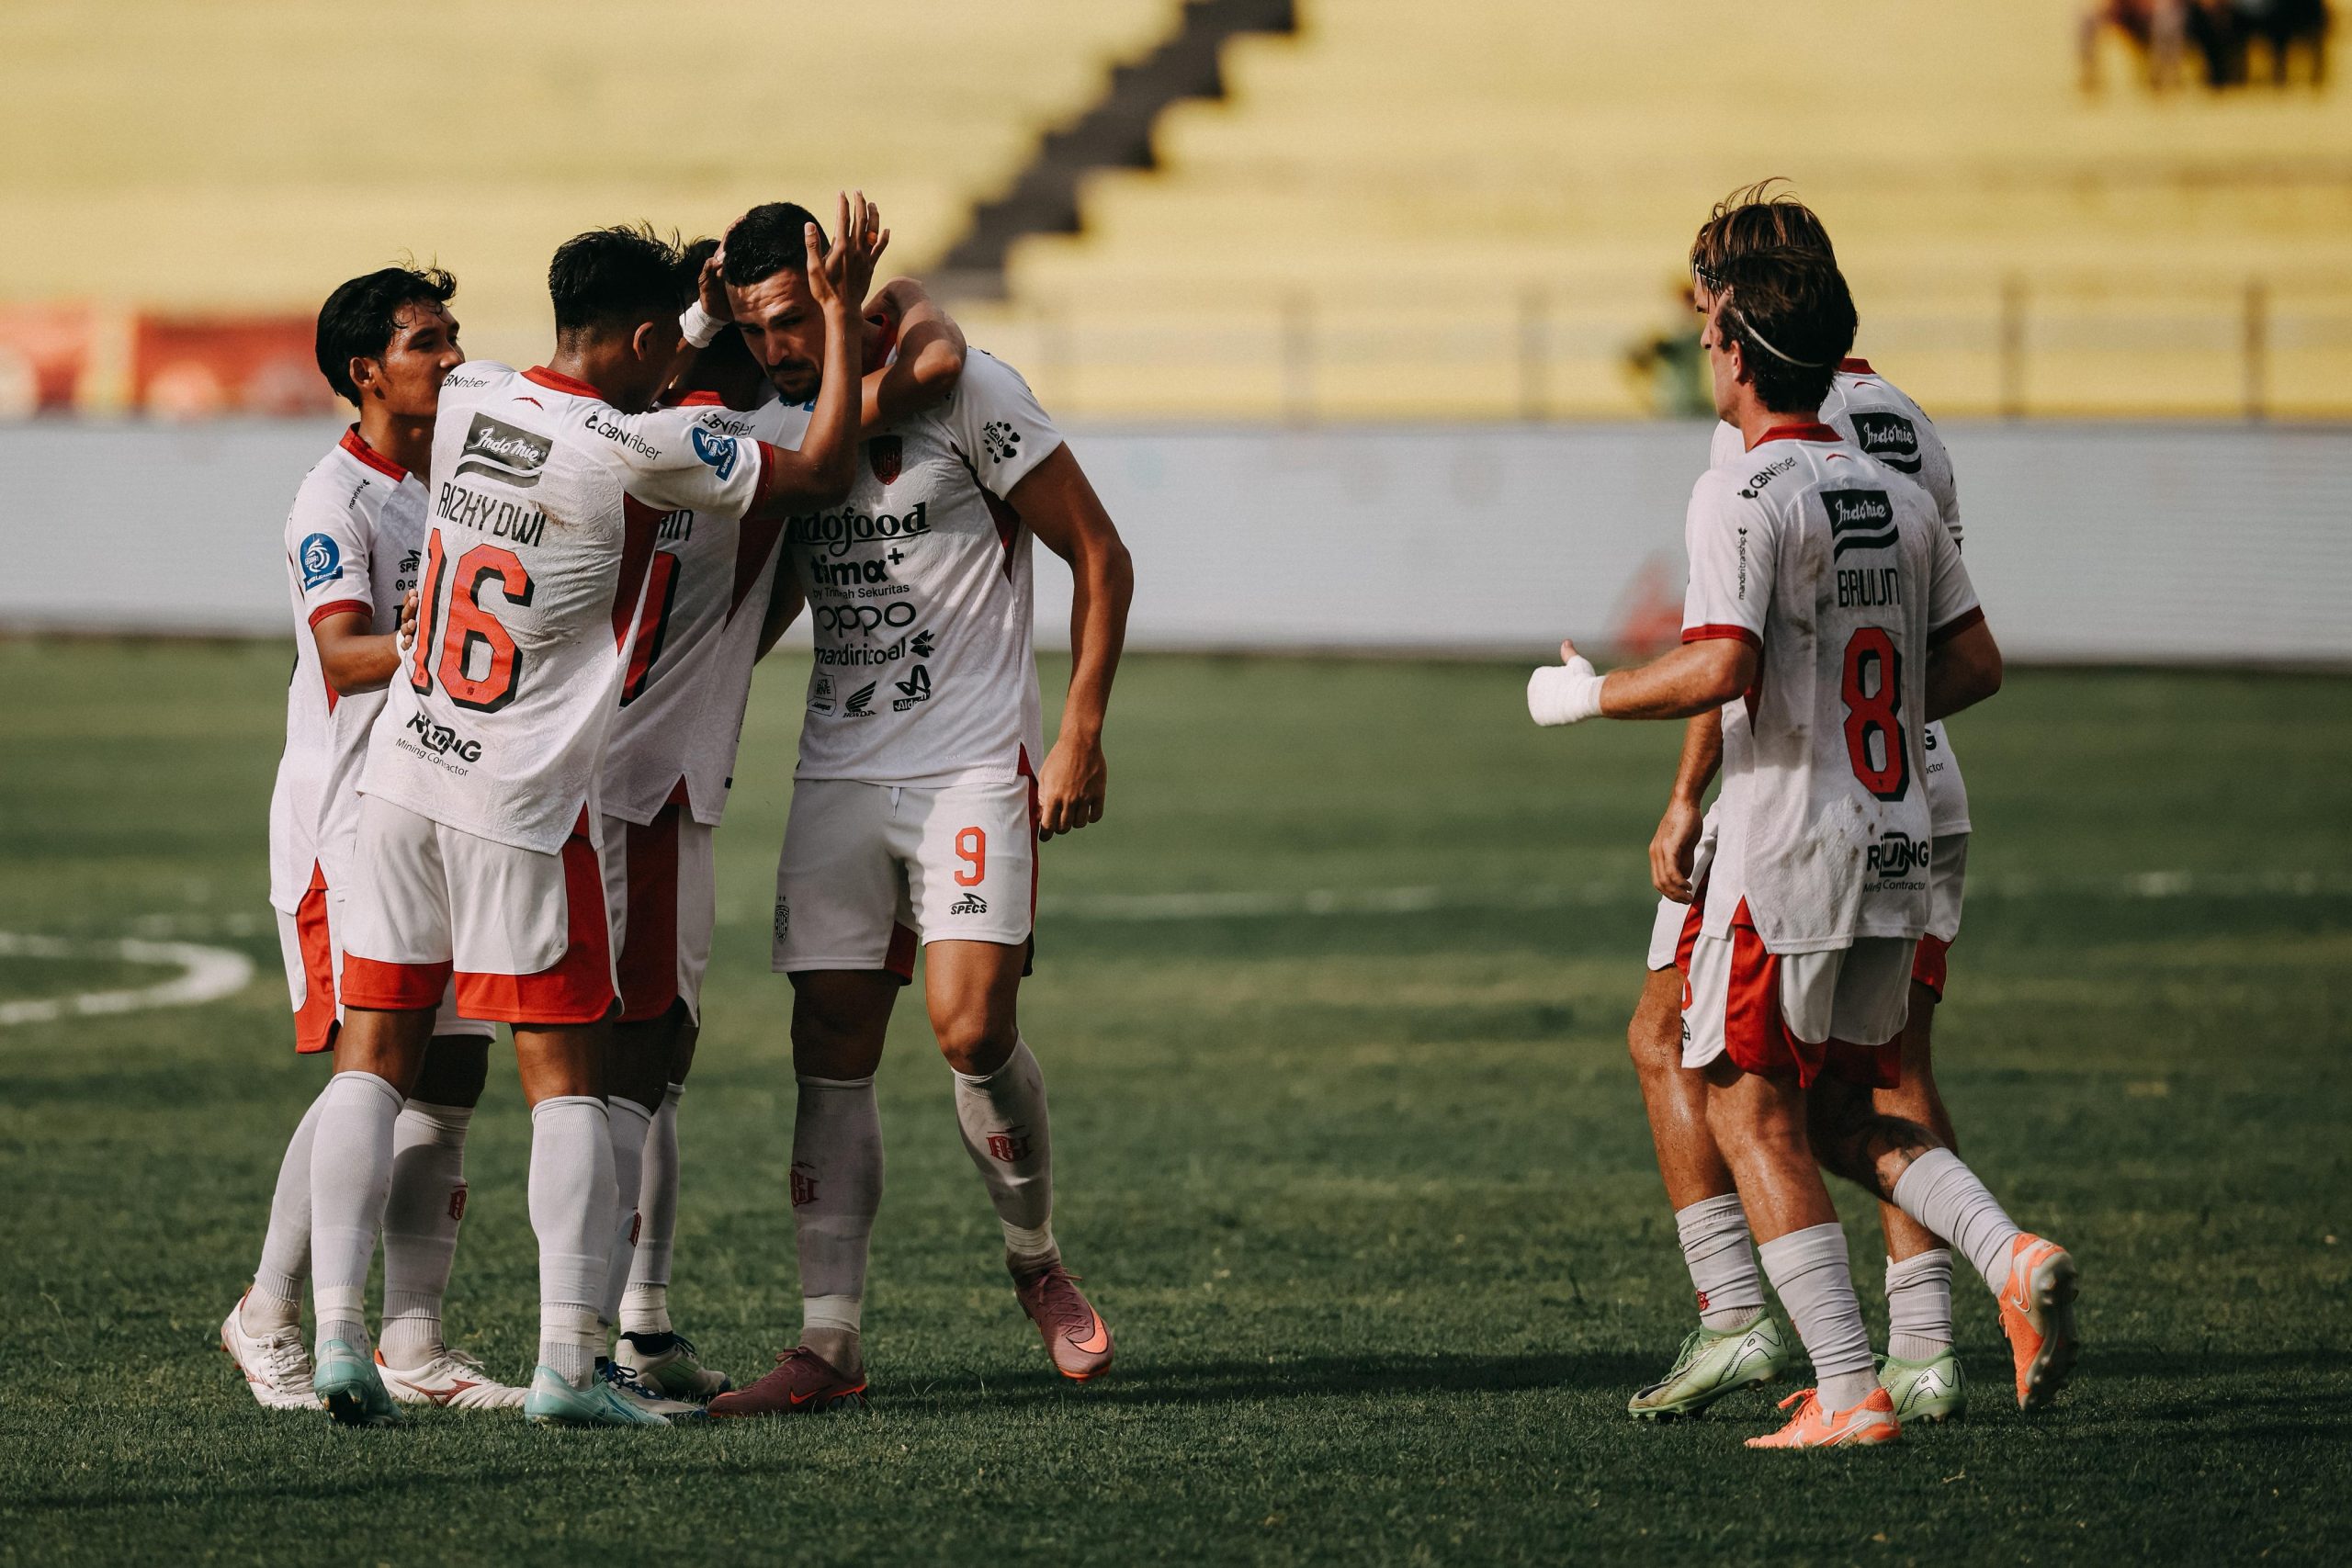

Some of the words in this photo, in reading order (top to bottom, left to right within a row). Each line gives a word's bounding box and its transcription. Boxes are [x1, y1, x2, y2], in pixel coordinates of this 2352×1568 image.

[436, 481, 497, 530] RIZKY
[492, 502, 547, 547] DWI
[788, 501, 931, 558] ndofood
[400, 561, 420, 573] SPE
[1837, 568, 1901, 608] BRUIJN
[858, 584, 910, 599] Sekuritas
[411, 527, 535, 714] 16
[1841, 627, 1910, 802] 8
[395, 738, 427, 760] Mining
[955, 826, 986, 886] 9
[950, 904, 987, 915] SPECS
